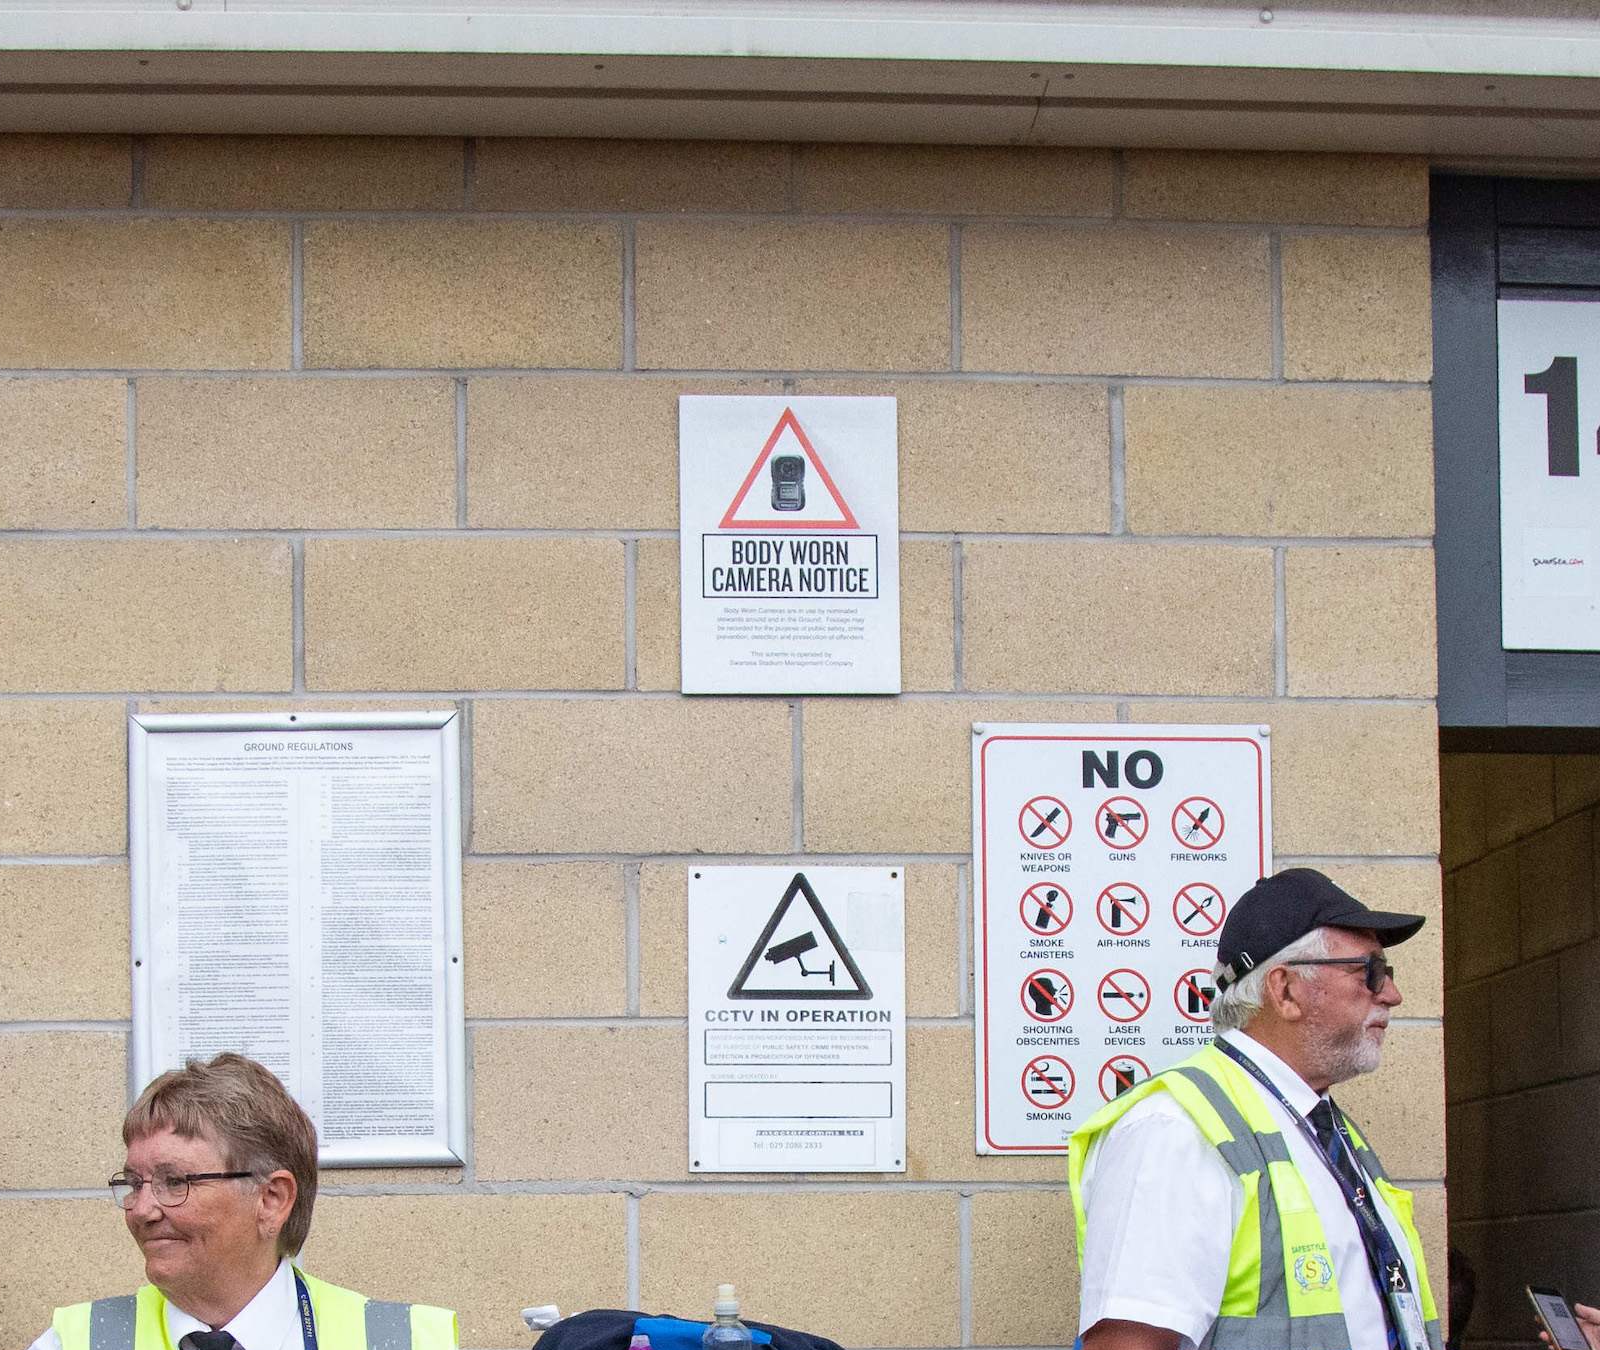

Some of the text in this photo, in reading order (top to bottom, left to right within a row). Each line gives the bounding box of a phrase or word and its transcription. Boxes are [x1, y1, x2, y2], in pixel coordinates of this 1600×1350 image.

[732, 540, 848, 565] BODY WORN
[712, 568, 869, 592] CAMERA NOTICE
[244, 742, 353, 752] GROUND REGULATIONS
[1082, 750, 1164, 790] NO
[1020, 853, 1072, 861] KNIVES OR
[1109, 853, 1136, 861] GUNS
[1170, 853, 1227, 862] FIREWORKS
[1022, 864, 1071, 873] WEAPONS
[1030, 939, 1064, 948] SMOKE
[1097, 939, 1150, 948] AIR-HORNS
[1020, 951, 1074, 959] CANISTERS
[705, 1010, 891, 1022] CCTV IN OPERATION
[1023, 1026, 1073, 1034] SHOUTING
[1109, 1026, 1141, 1034] LASER
[1016, 1037, 1080, 1046] OBSCENITIES
[1104, 1037, 1146, 1046] DEVICES
[1162, 1038, 1194, 1046] GLASS
[1026, 1112, 1071, 1121] SMOKING
[1306, 1261, 1316, 1278] S
